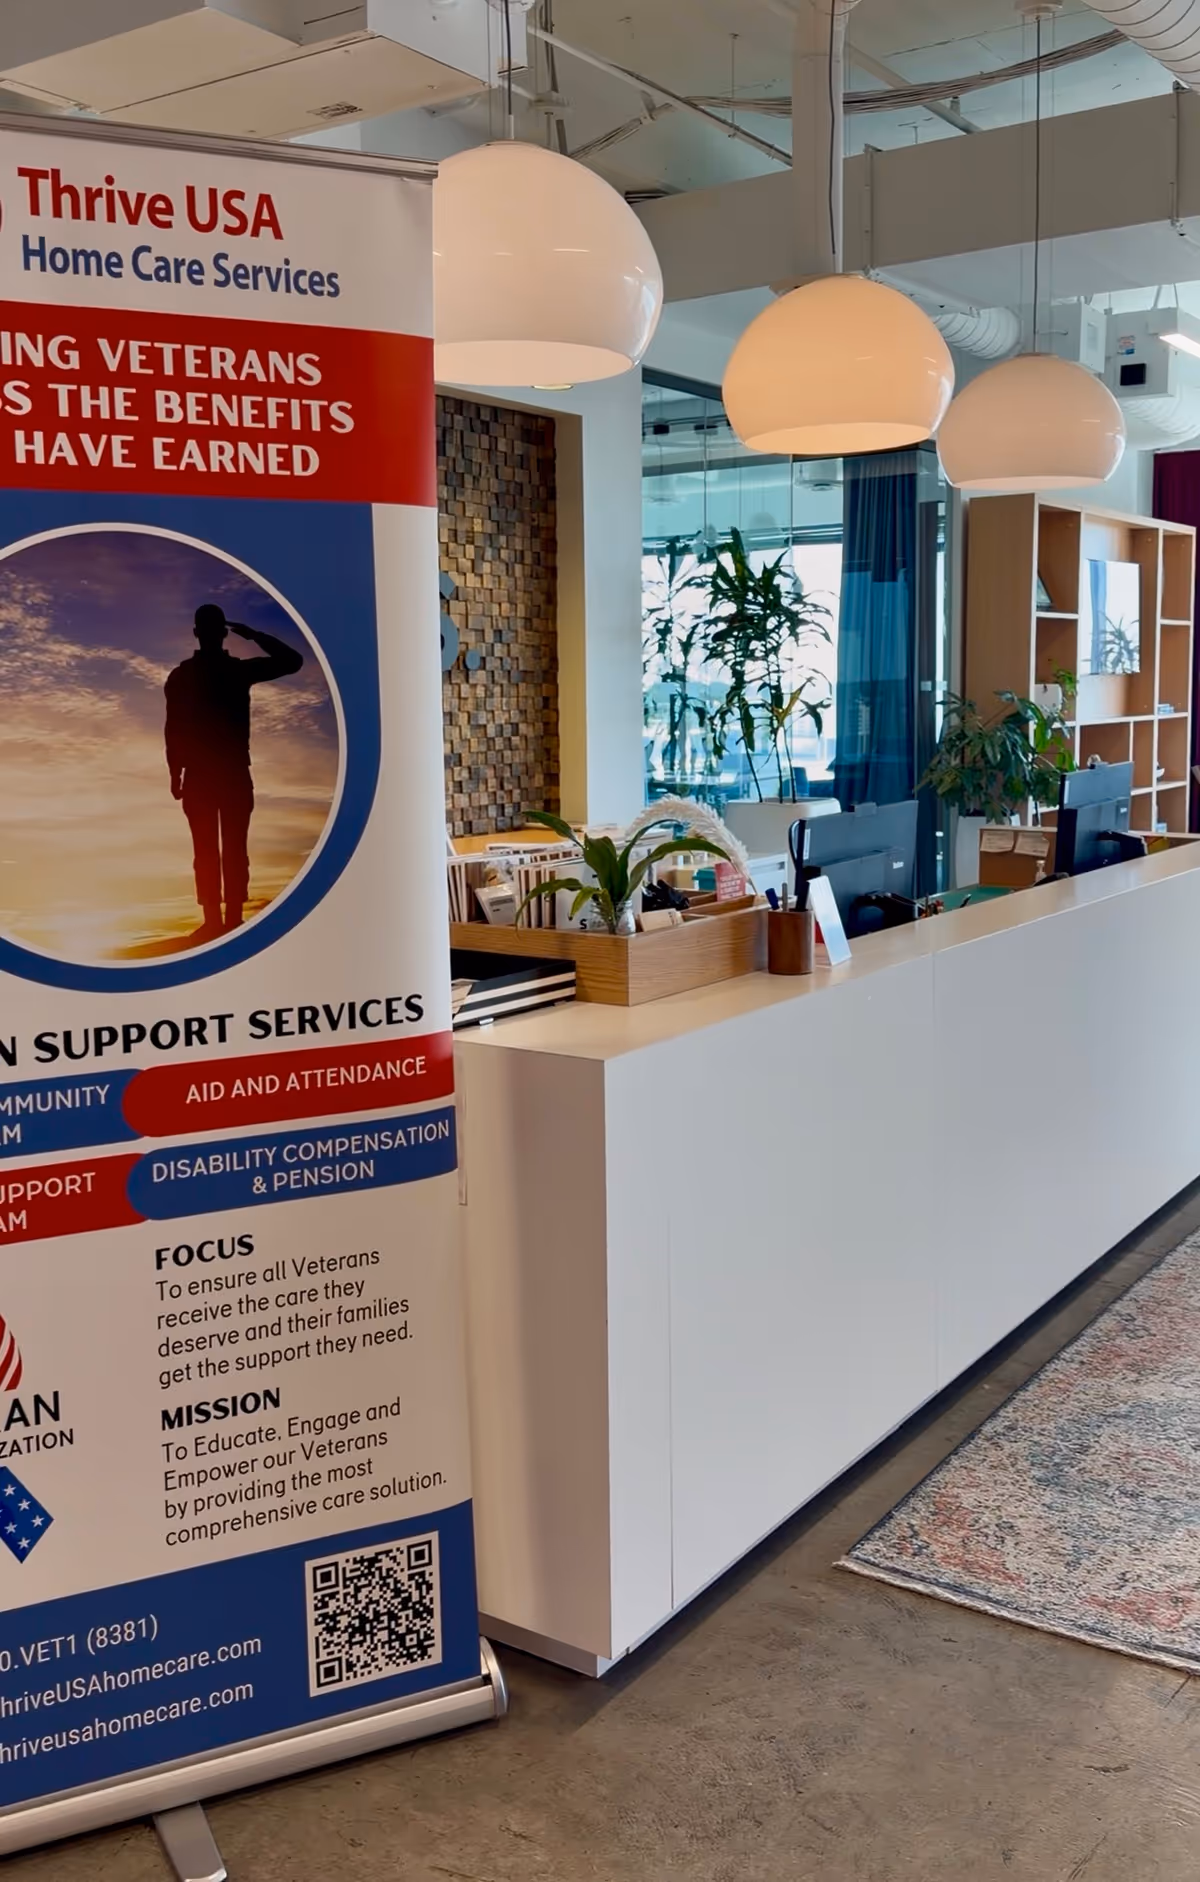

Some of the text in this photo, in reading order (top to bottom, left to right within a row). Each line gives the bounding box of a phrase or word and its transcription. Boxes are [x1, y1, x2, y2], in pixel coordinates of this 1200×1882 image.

[17, 167, 283, 240] Thrive USA
[22, 234, 340, 298] Home Care Services
[97, 338, 322, 386] VETERANS
[0, 380, 355, 434] S THE BENEFITS
[14, 429, 320, 477] HAVE EARNED
[33, 1014, 234, 1064] SUPPORT
[249, 993, 424, 1040] SERVICES
[186, 1056, 427, 1104] AID AND ATTENDANCE
[0, 1123, 21, 1146] M
[152, 1119, 450, 1184] DISABILITY COMPENSATION
[252, 1160, 375, 1195] & PENSION
[155, 1234, 255, 1270] FOCUS
[156, 1250, 380, 1301] To ensure all Veterans
[157, 1278, 365, 1330] receive the care they
[158, 1297, 409, 1357] deserve and their families
[158, 1321, 413, 1389] get the support they need.
[161, 1387, 281, 1431] MISSION
[162, 1442, 188, 1463] To
[288, 1408, 361, 1440] Engage
[366, 1397, 401, 1422] and
[164, 1431, 388, 1491] Empower our Veterans
[165, 1458, 374, 1523] by providing the most
[166, 1469, 446, 1546] comprehensive care solution.
[87, 1614, 159, 1655] (8381)
